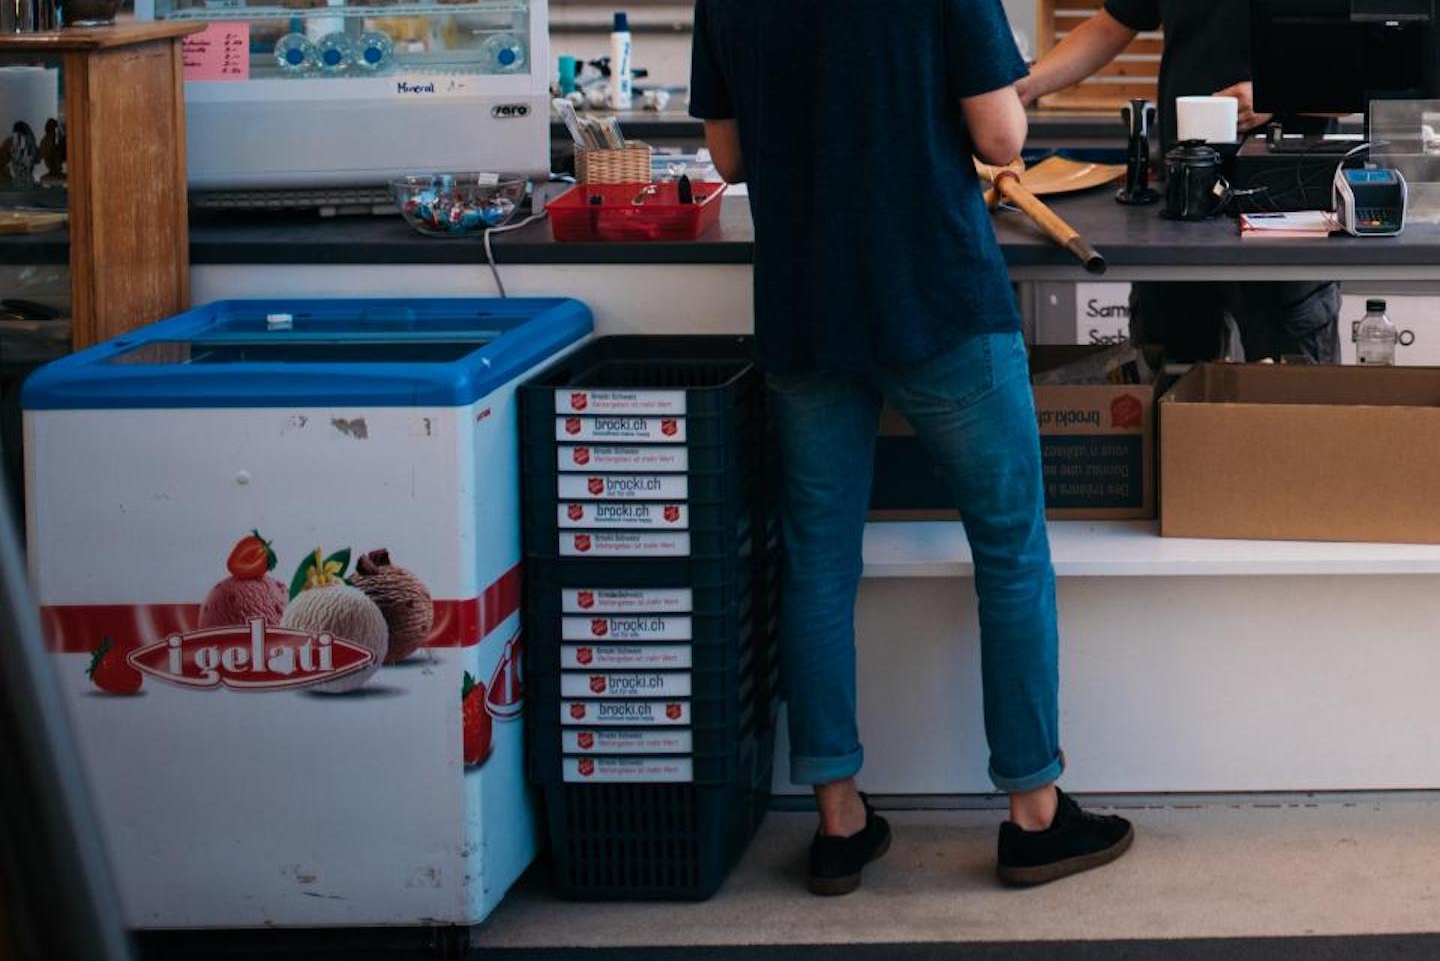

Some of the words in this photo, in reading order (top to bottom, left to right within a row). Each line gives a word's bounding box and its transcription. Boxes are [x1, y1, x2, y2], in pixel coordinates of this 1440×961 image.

[397, 81, 435, 94] Mineral
[595, 418, 647, 430] brocki.ch
[607, 477, 661, 490] brocki.ch
[597, 502, 649, 517] brocki.ch
[610, 618, 665, 632] brocki.ch
[166, 633, 185, 675] i
[193, 616, 338, 686] gelati
[609, 674, 664, 688] brocki.ch
[599, 702, 652, 715] brocki.ch
